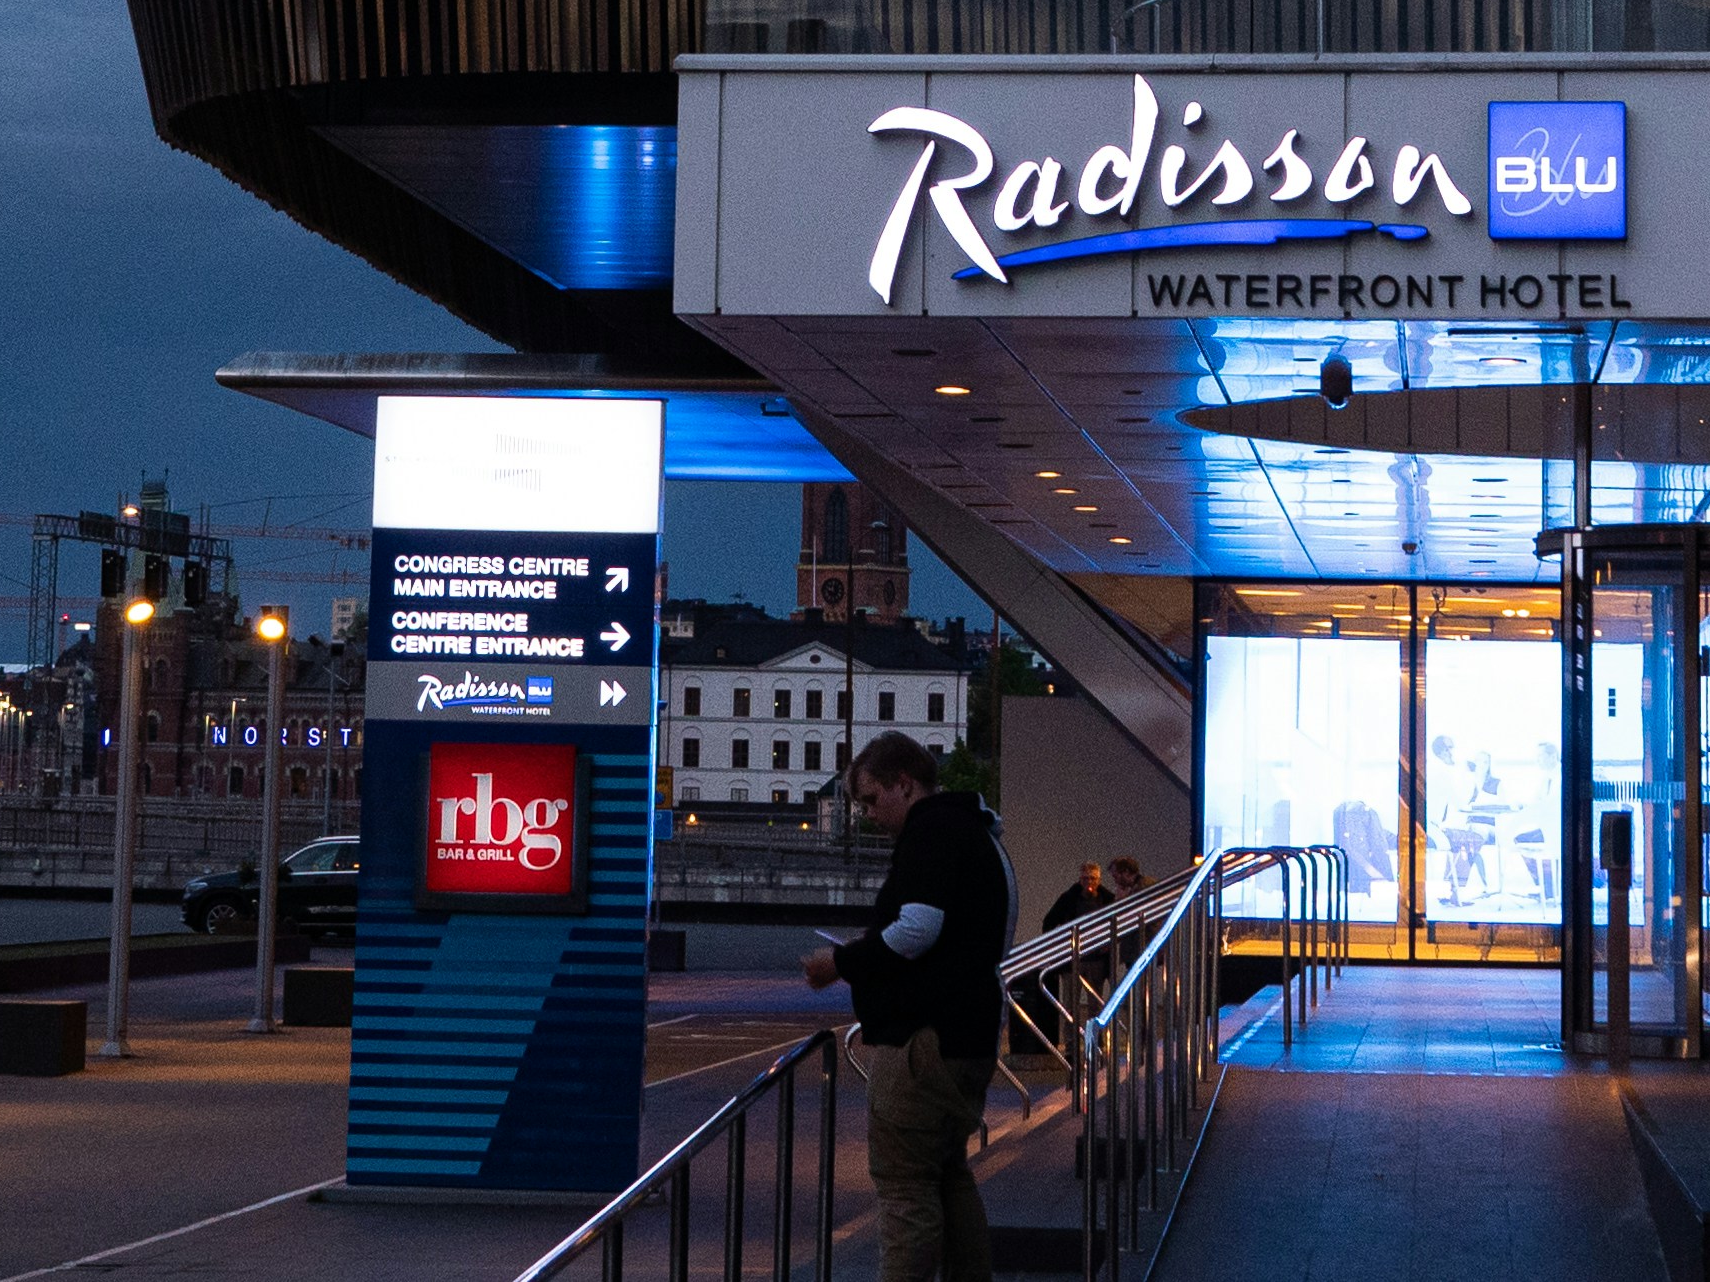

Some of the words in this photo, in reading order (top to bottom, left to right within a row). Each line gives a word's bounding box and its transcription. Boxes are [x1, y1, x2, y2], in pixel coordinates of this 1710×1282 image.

[867, 73, 1472, 305] Radisson
[1496, 156, 1617, 193] BLU
[1148, 273, 1464, 309] WATERFRONT
[1481, 274, 1632, 310] HOTEL
[394, 555, 504, 574] CONGRESS
[508, 557, 589, 576] CENTRE
[394, 578, 445, 597] MAIN
[449, 579, 557, 599] ENTRANCE
[391, 611, 528, 632] CONFERENCE
[391, 634, 472, 654] CENTRE
[475, 636, 584, 657] ENTRANCE
[417, 670, 526, 713] Radisson
[471, 706, 524, 715] WATERFRONT
[526, 707, 551, 716] HOTEL
[435, 772, 568, 870] rbg
[437, 848, 464, 860] BAR
[465, 849, 475, 860] &
[477, 848, 514, 861] GRILL
